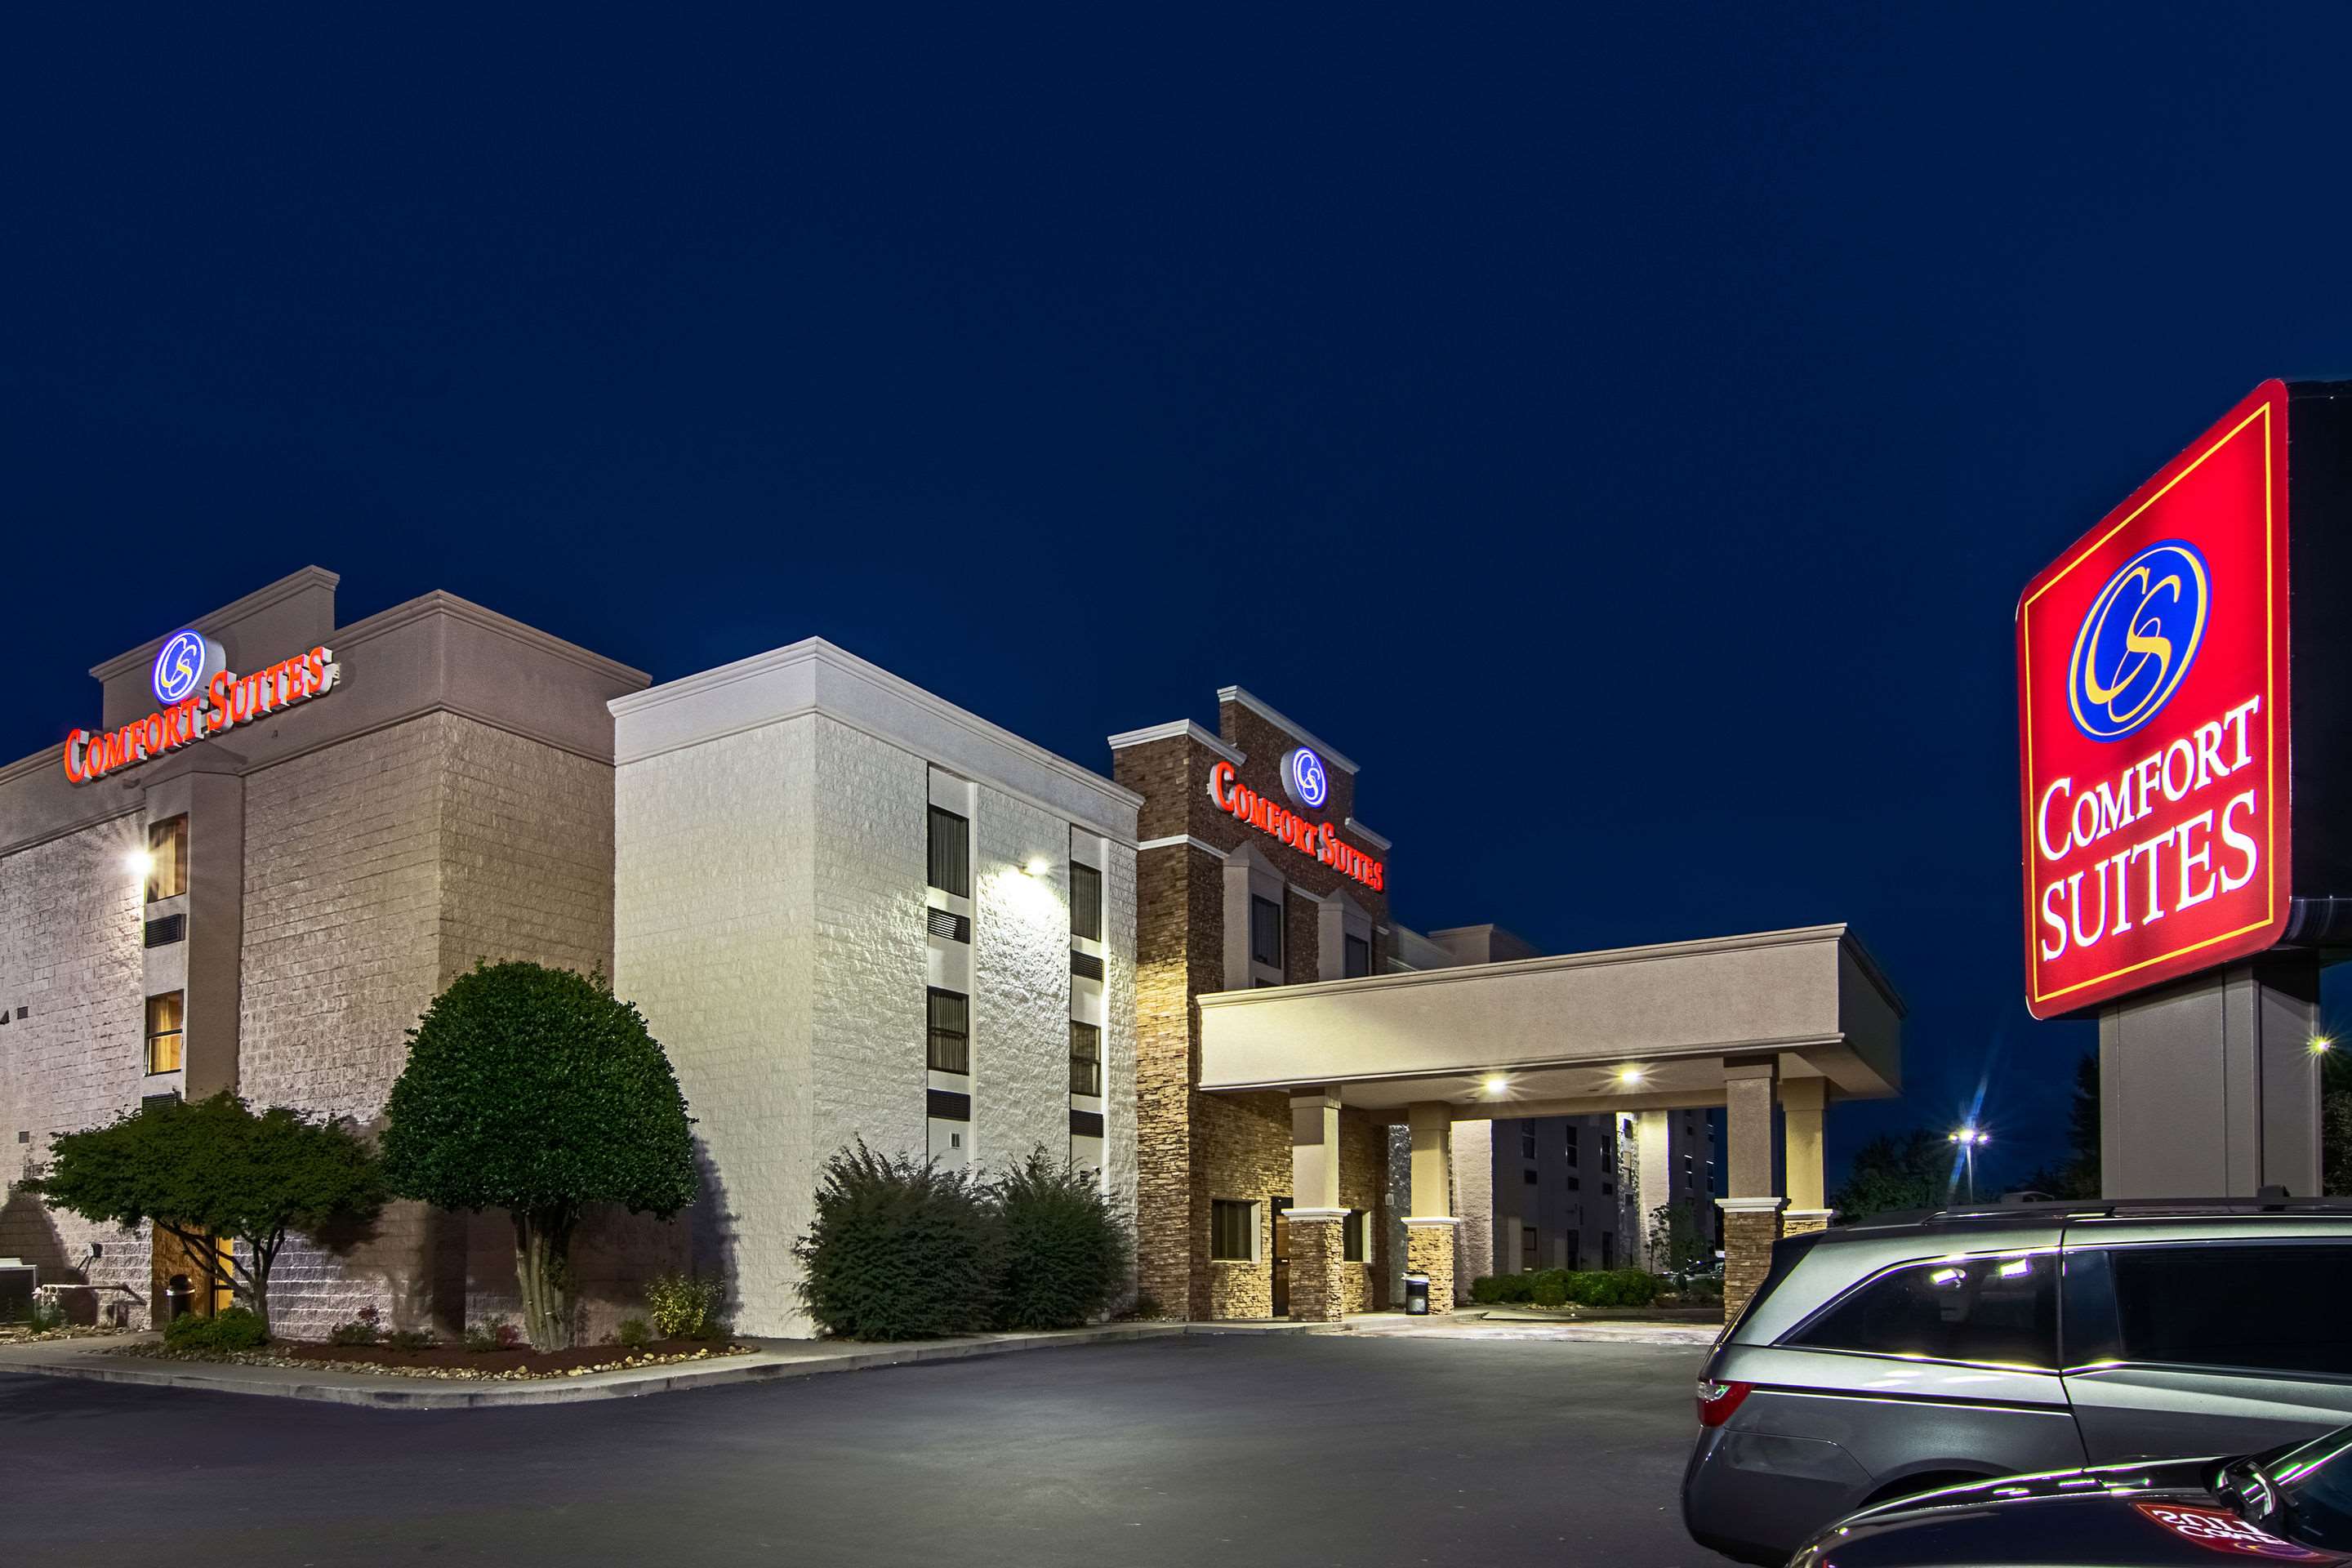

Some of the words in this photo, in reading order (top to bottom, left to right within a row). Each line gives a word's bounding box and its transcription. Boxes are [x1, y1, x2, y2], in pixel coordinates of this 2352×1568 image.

[64, 697, 201, 783] COMFORT
[207, 646, 330, 733] SUITES
[2038, 694, 2261, 862] COMFORT
[1214, 760, 1318, 857] COMFORT
[1321, 822, 1383, 892] SUITES
[2042, 789, 2259, 961] SUITES
